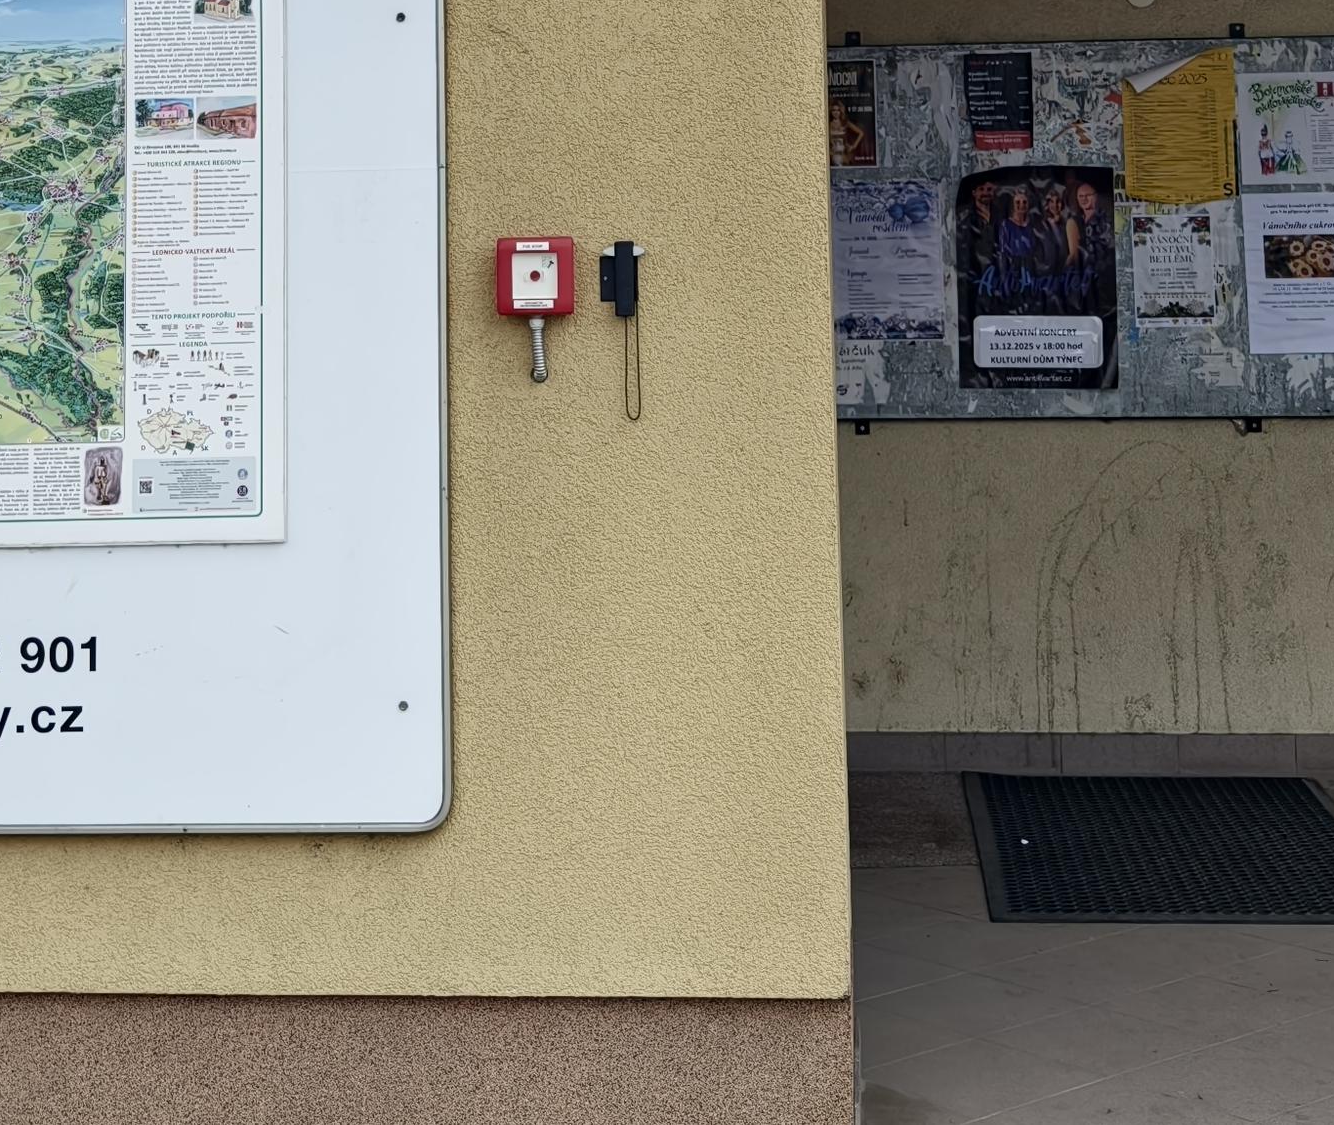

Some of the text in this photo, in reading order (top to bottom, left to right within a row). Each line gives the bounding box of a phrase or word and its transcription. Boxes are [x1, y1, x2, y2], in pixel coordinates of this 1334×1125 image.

[146, 158, 241, 168] TURISTICKÉ ATRAKCE REGIONU
[1262, 220, 1307, 231] Vánočního
[994, 327, 1077, 337] ADVENTNÍ KONCERT
[989, 342, 1034, 351] 13.12.2025
[1043, 342, 1065, 350] 18:00
[1066, 342, 1083, 350] hod
[990, 354, 1083, 364] KULTURNÍ DŮM TÝNEC
[19, 635, 101, 674] 901
